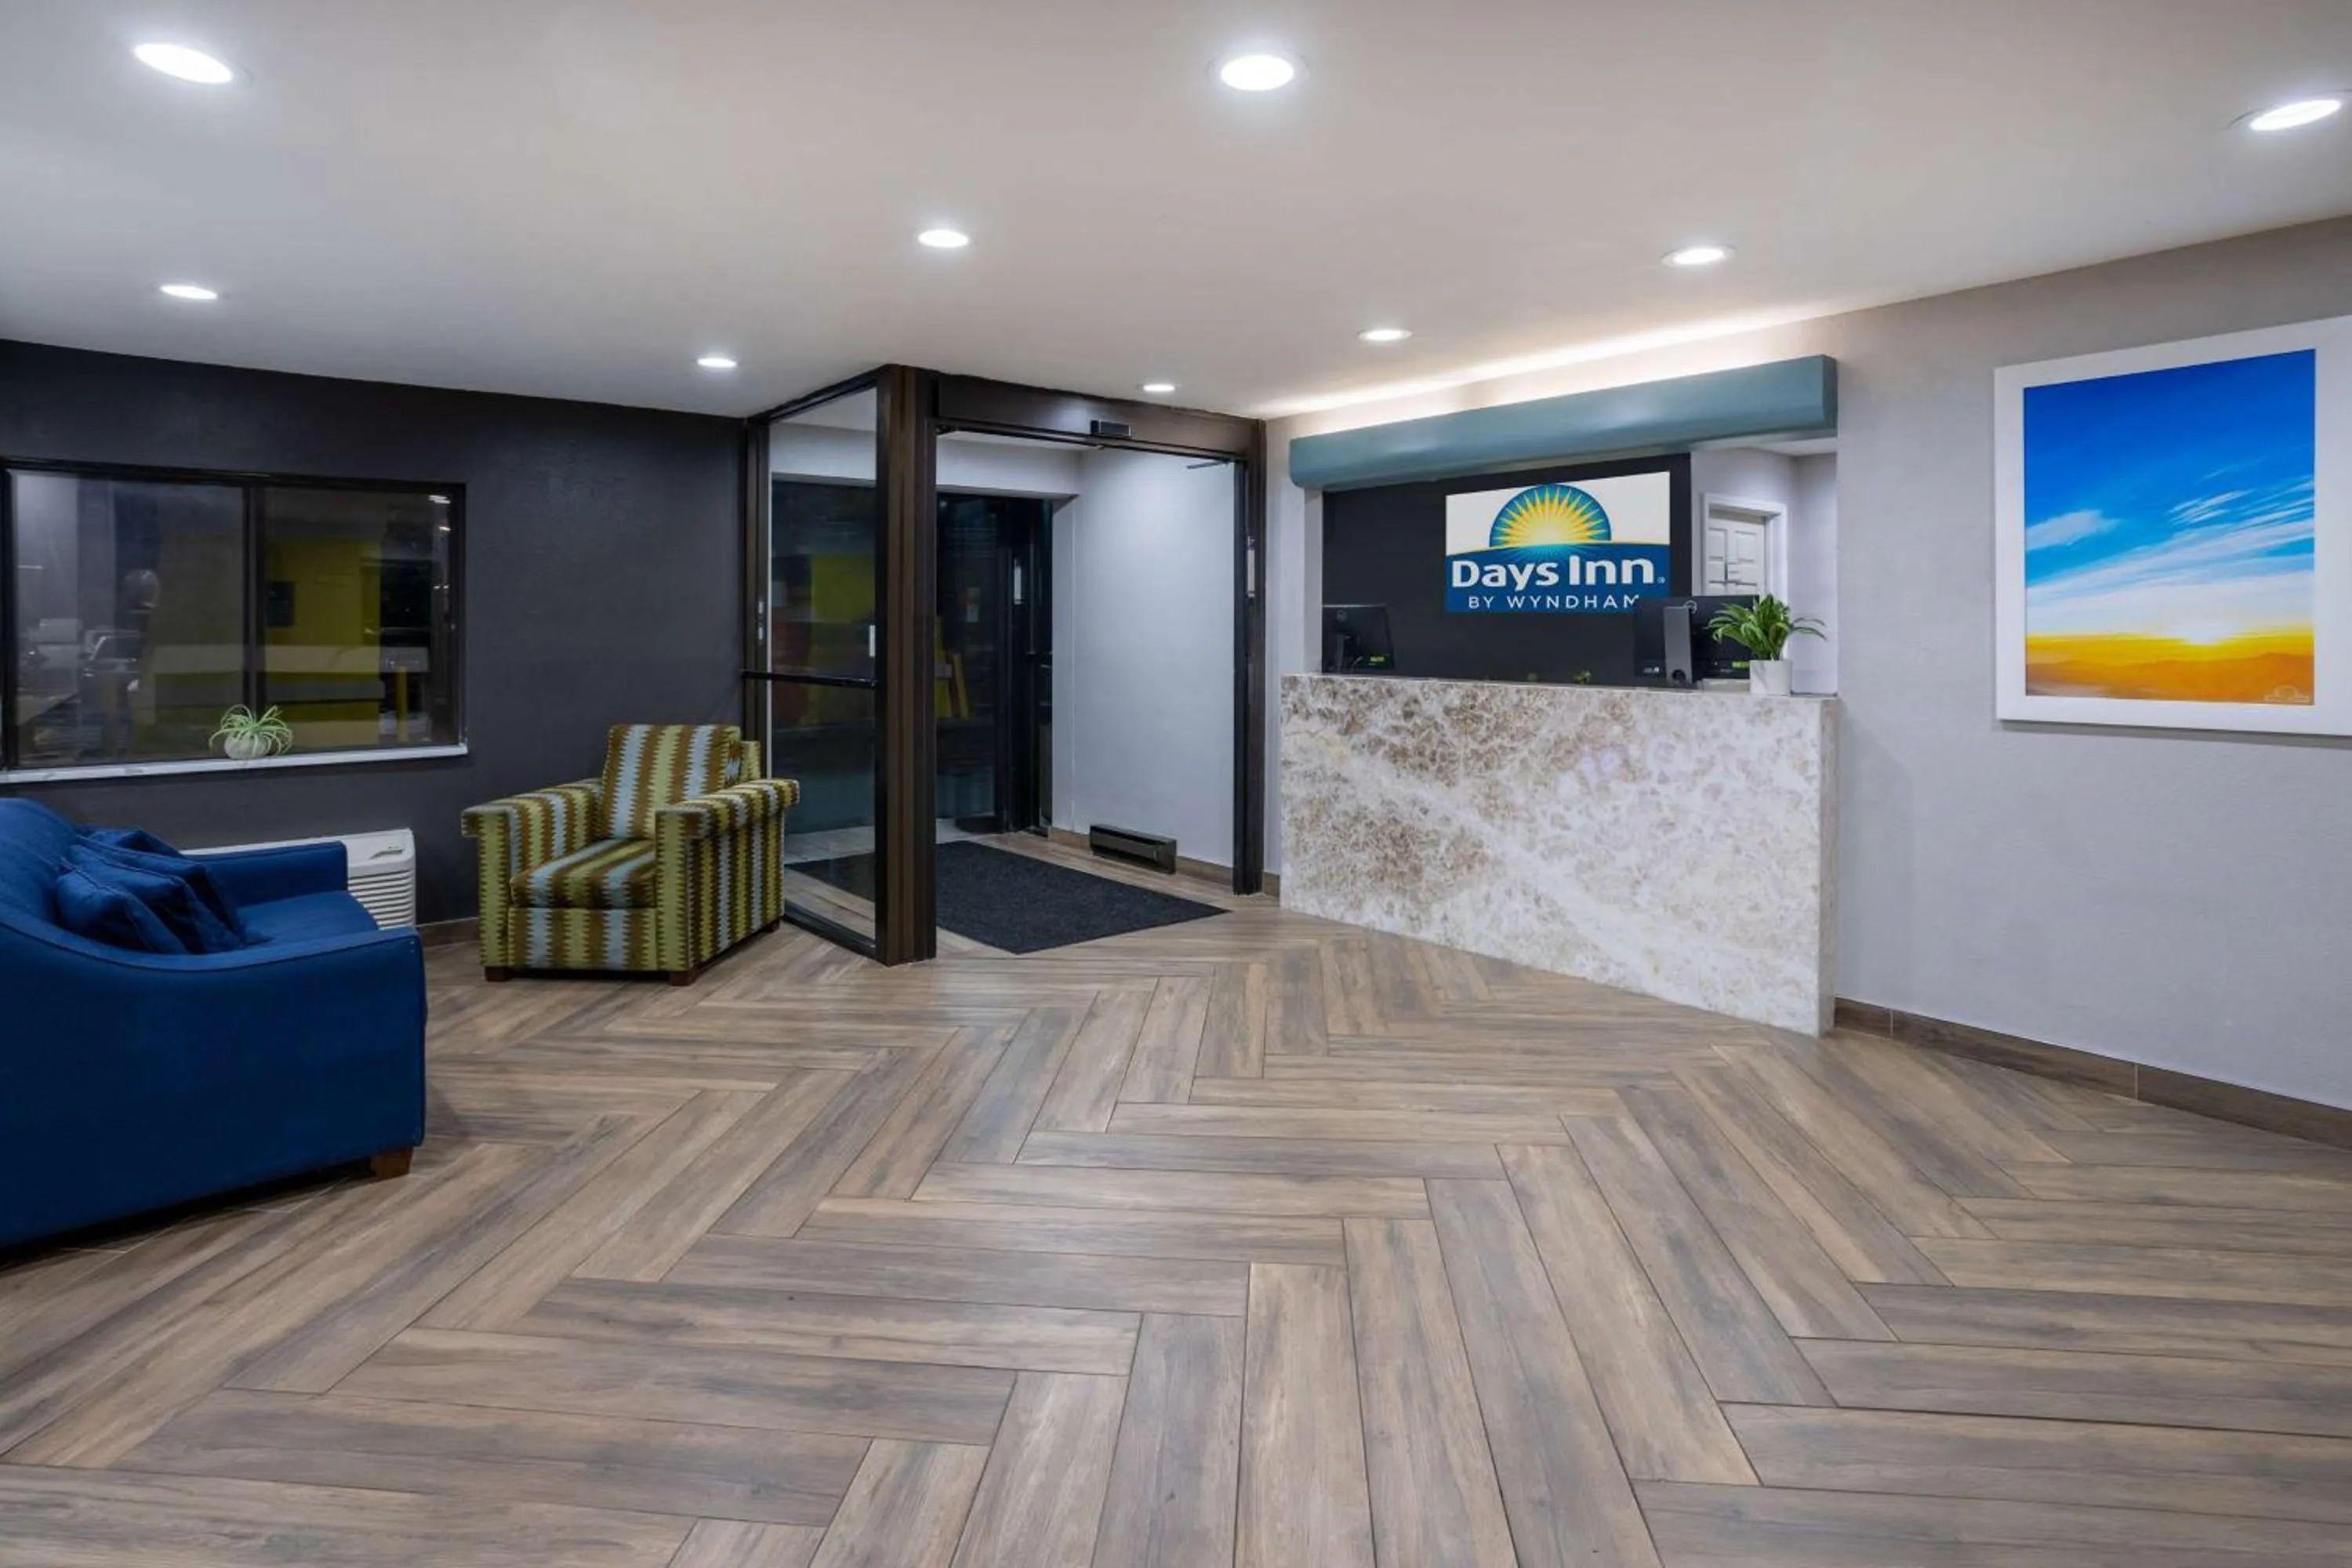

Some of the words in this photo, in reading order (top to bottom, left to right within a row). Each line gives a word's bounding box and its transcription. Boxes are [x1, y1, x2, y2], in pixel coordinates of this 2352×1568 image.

[1452, 560, 1559, 591] Days
[1570, 555, 1654, 585] Inn
[1468, 596, 1494, 609] BY
